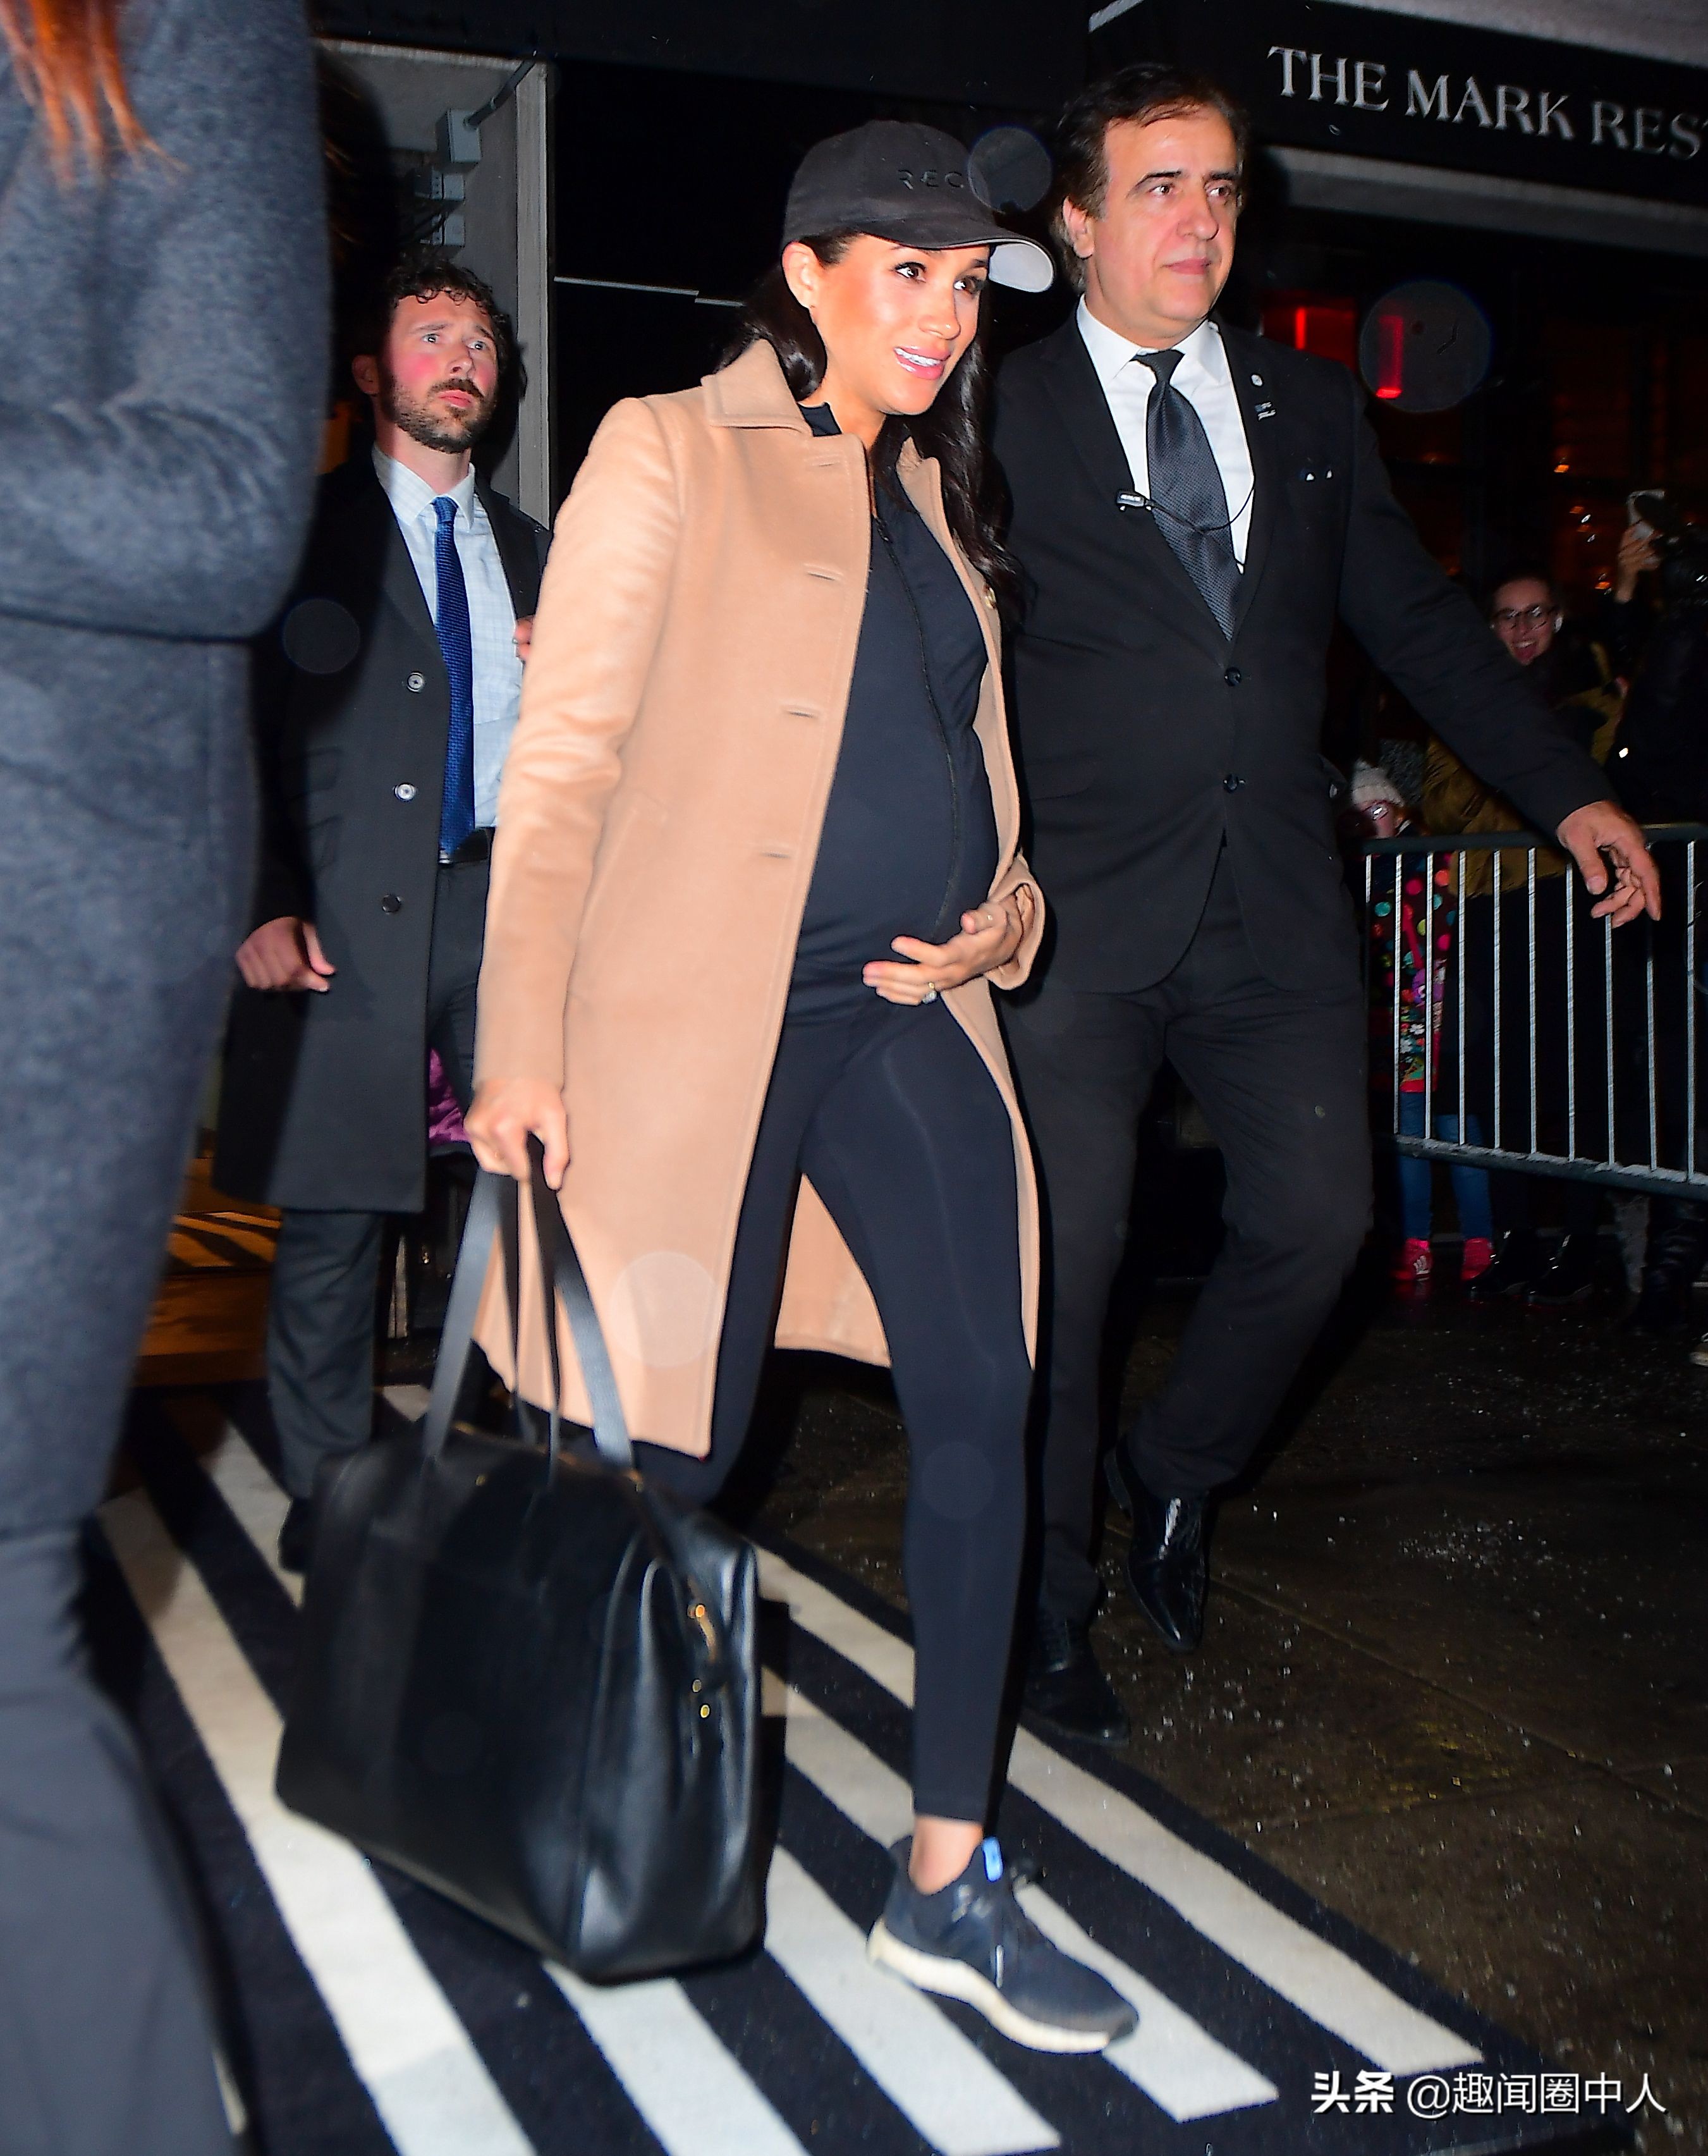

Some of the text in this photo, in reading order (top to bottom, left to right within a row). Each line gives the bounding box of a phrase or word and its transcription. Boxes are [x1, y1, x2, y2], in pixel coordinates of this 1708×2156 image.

[1266, 46, 1708, 161] THE MARK RES
